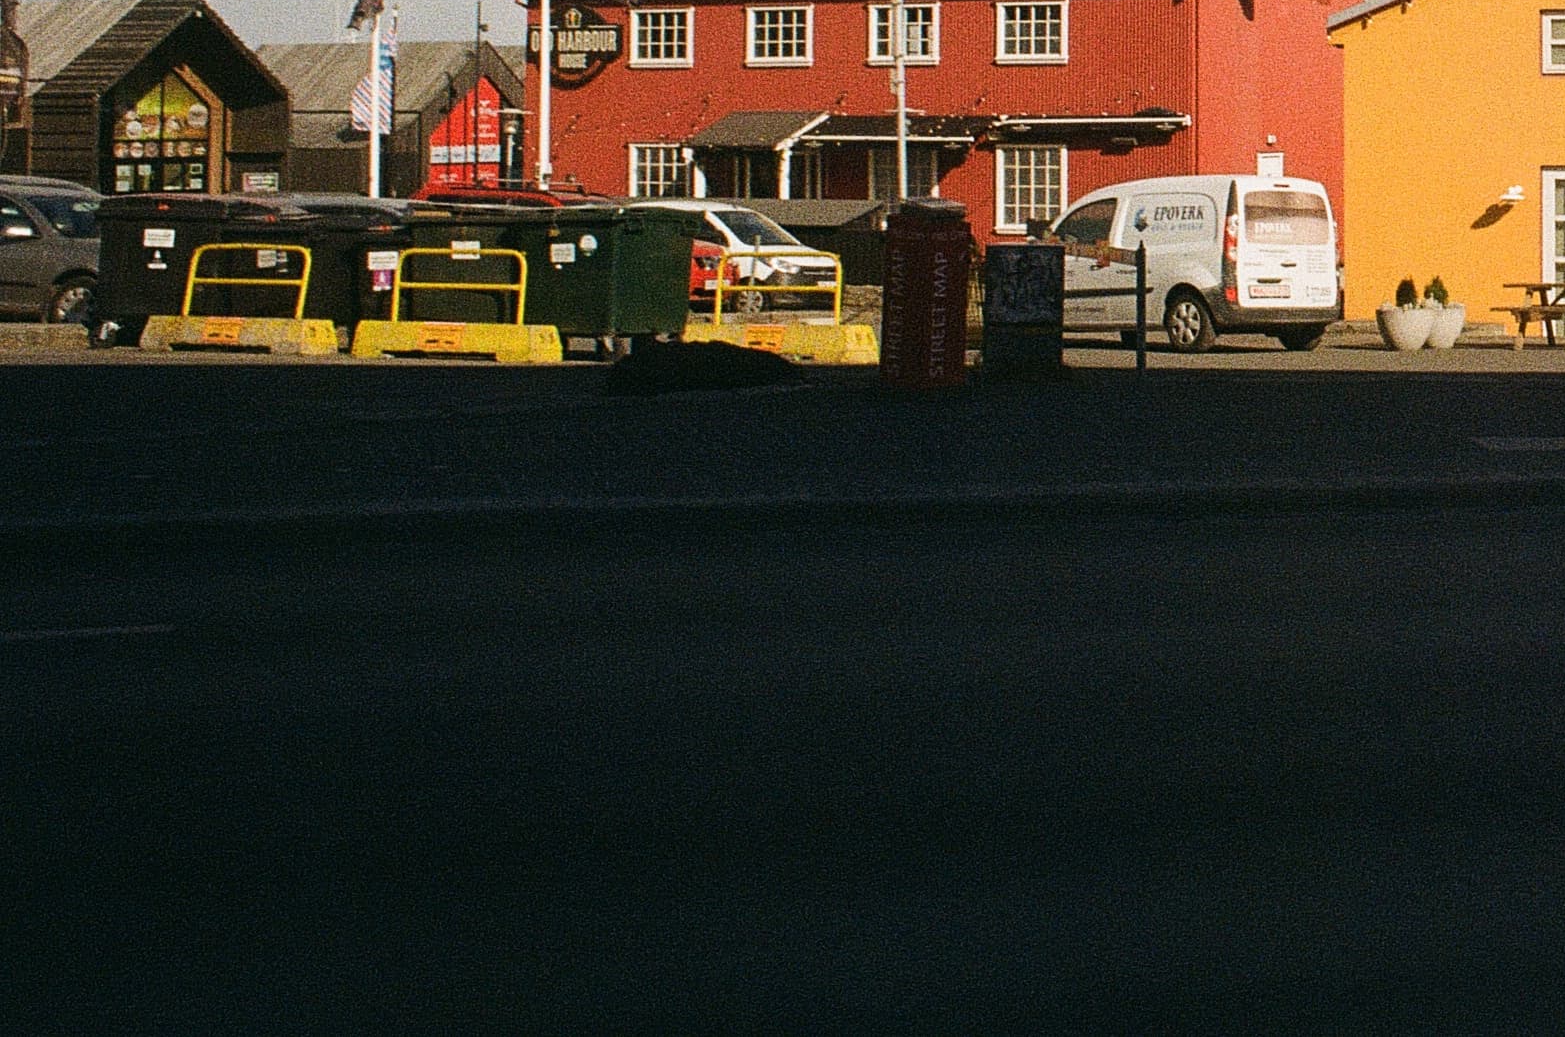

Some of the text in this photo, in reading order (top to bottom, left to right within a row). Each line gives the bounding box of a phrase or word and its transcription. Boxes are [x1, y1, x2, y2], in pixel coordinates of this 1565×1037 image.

[530, 30, 617, 52] OD HARBOUR
[928, 251, 948, 379] STREET MAP
